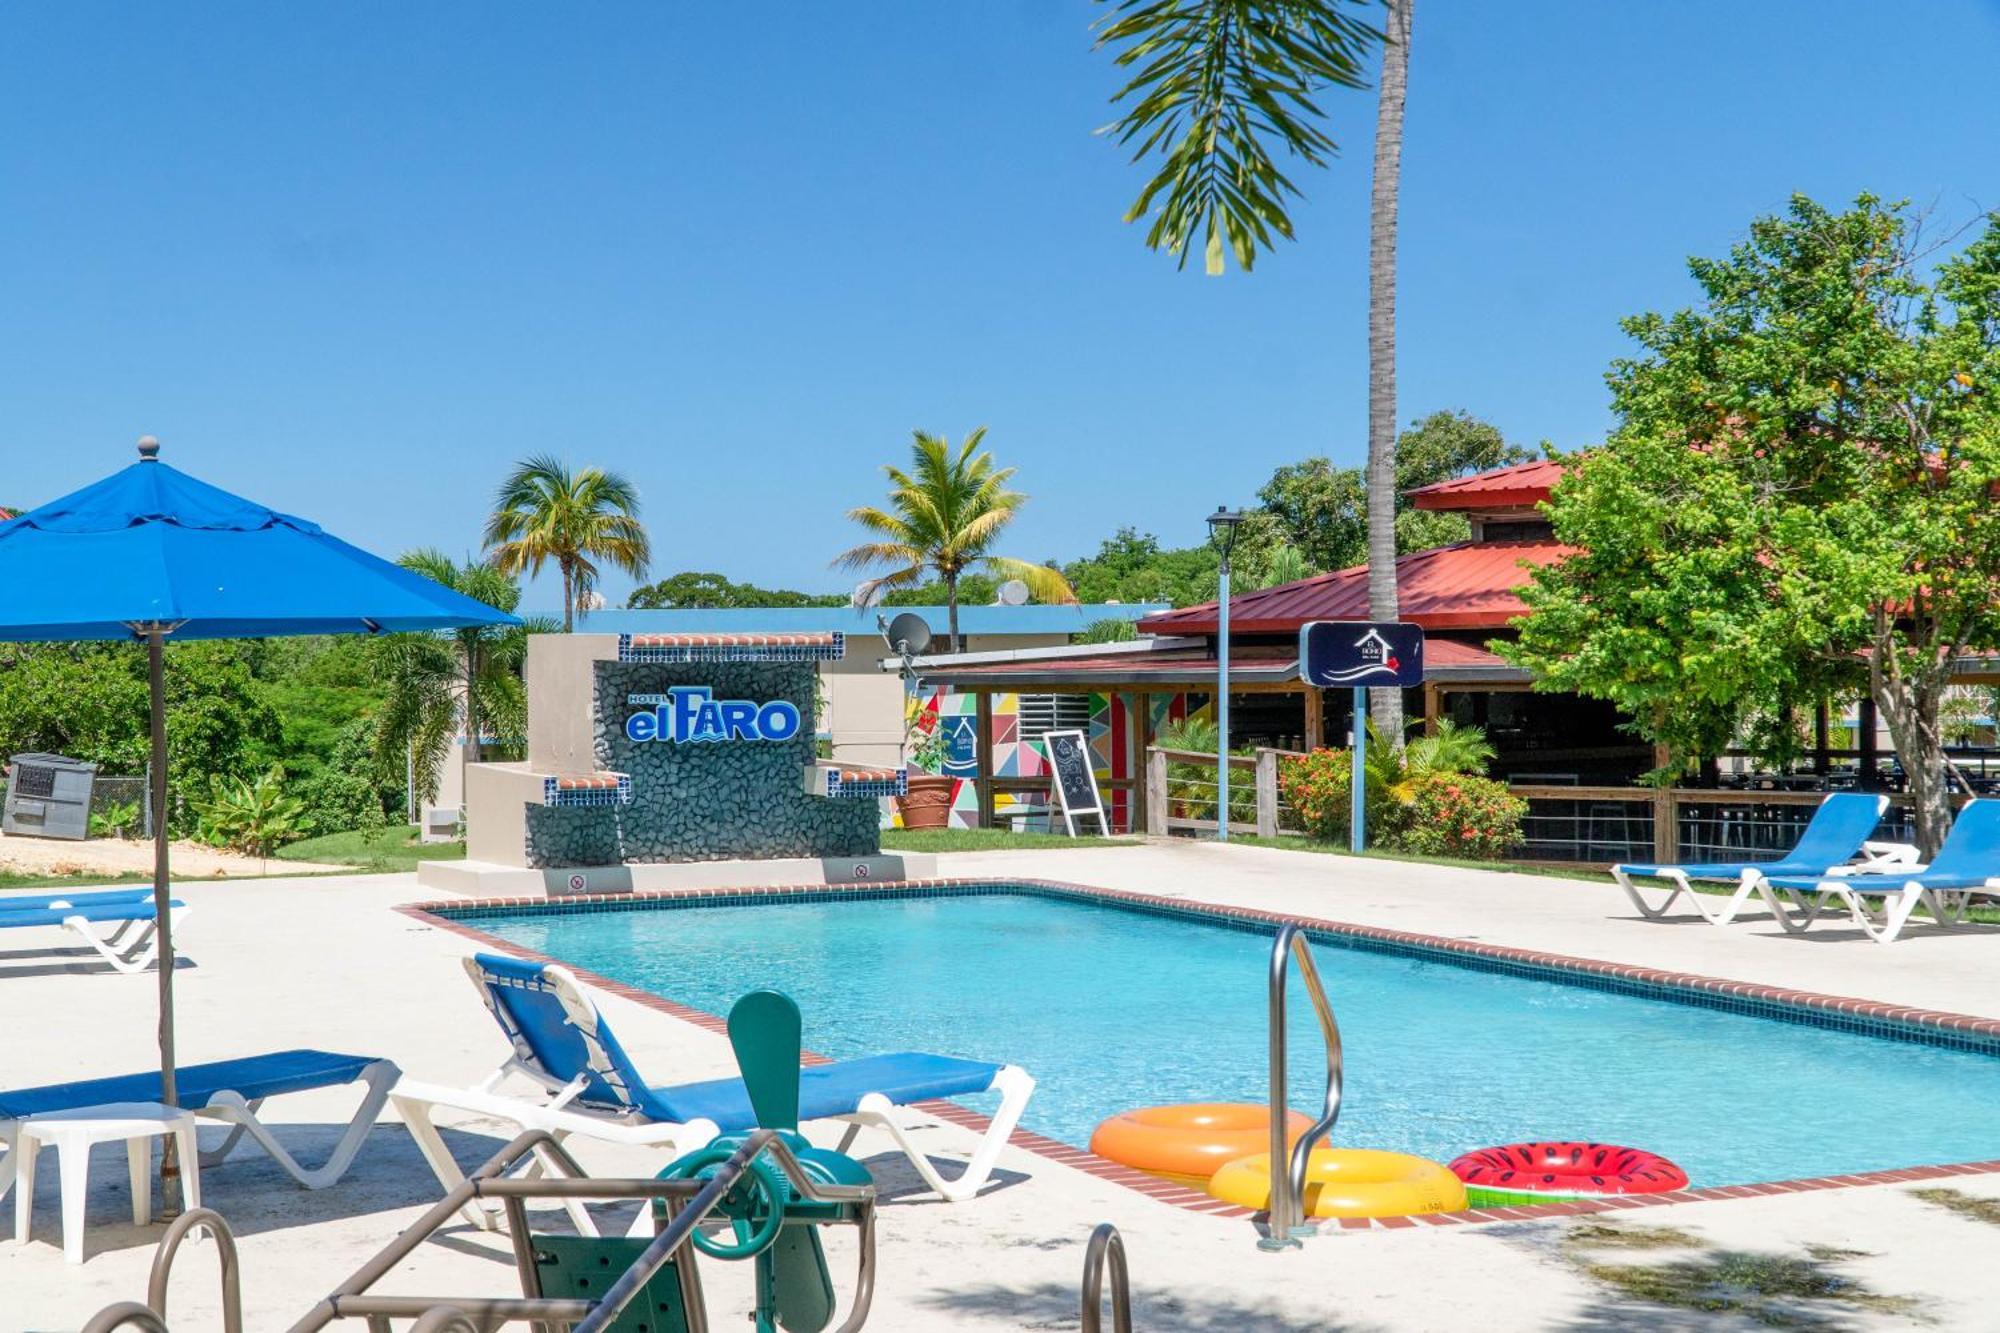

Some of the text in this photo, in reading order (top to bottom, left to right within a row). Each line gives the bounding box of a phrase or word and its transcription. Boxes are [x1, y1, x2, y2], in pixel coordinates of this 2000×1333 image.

[626, 686, 800, 744] el FARO
[628, 694, 669, 704] HOTEL
